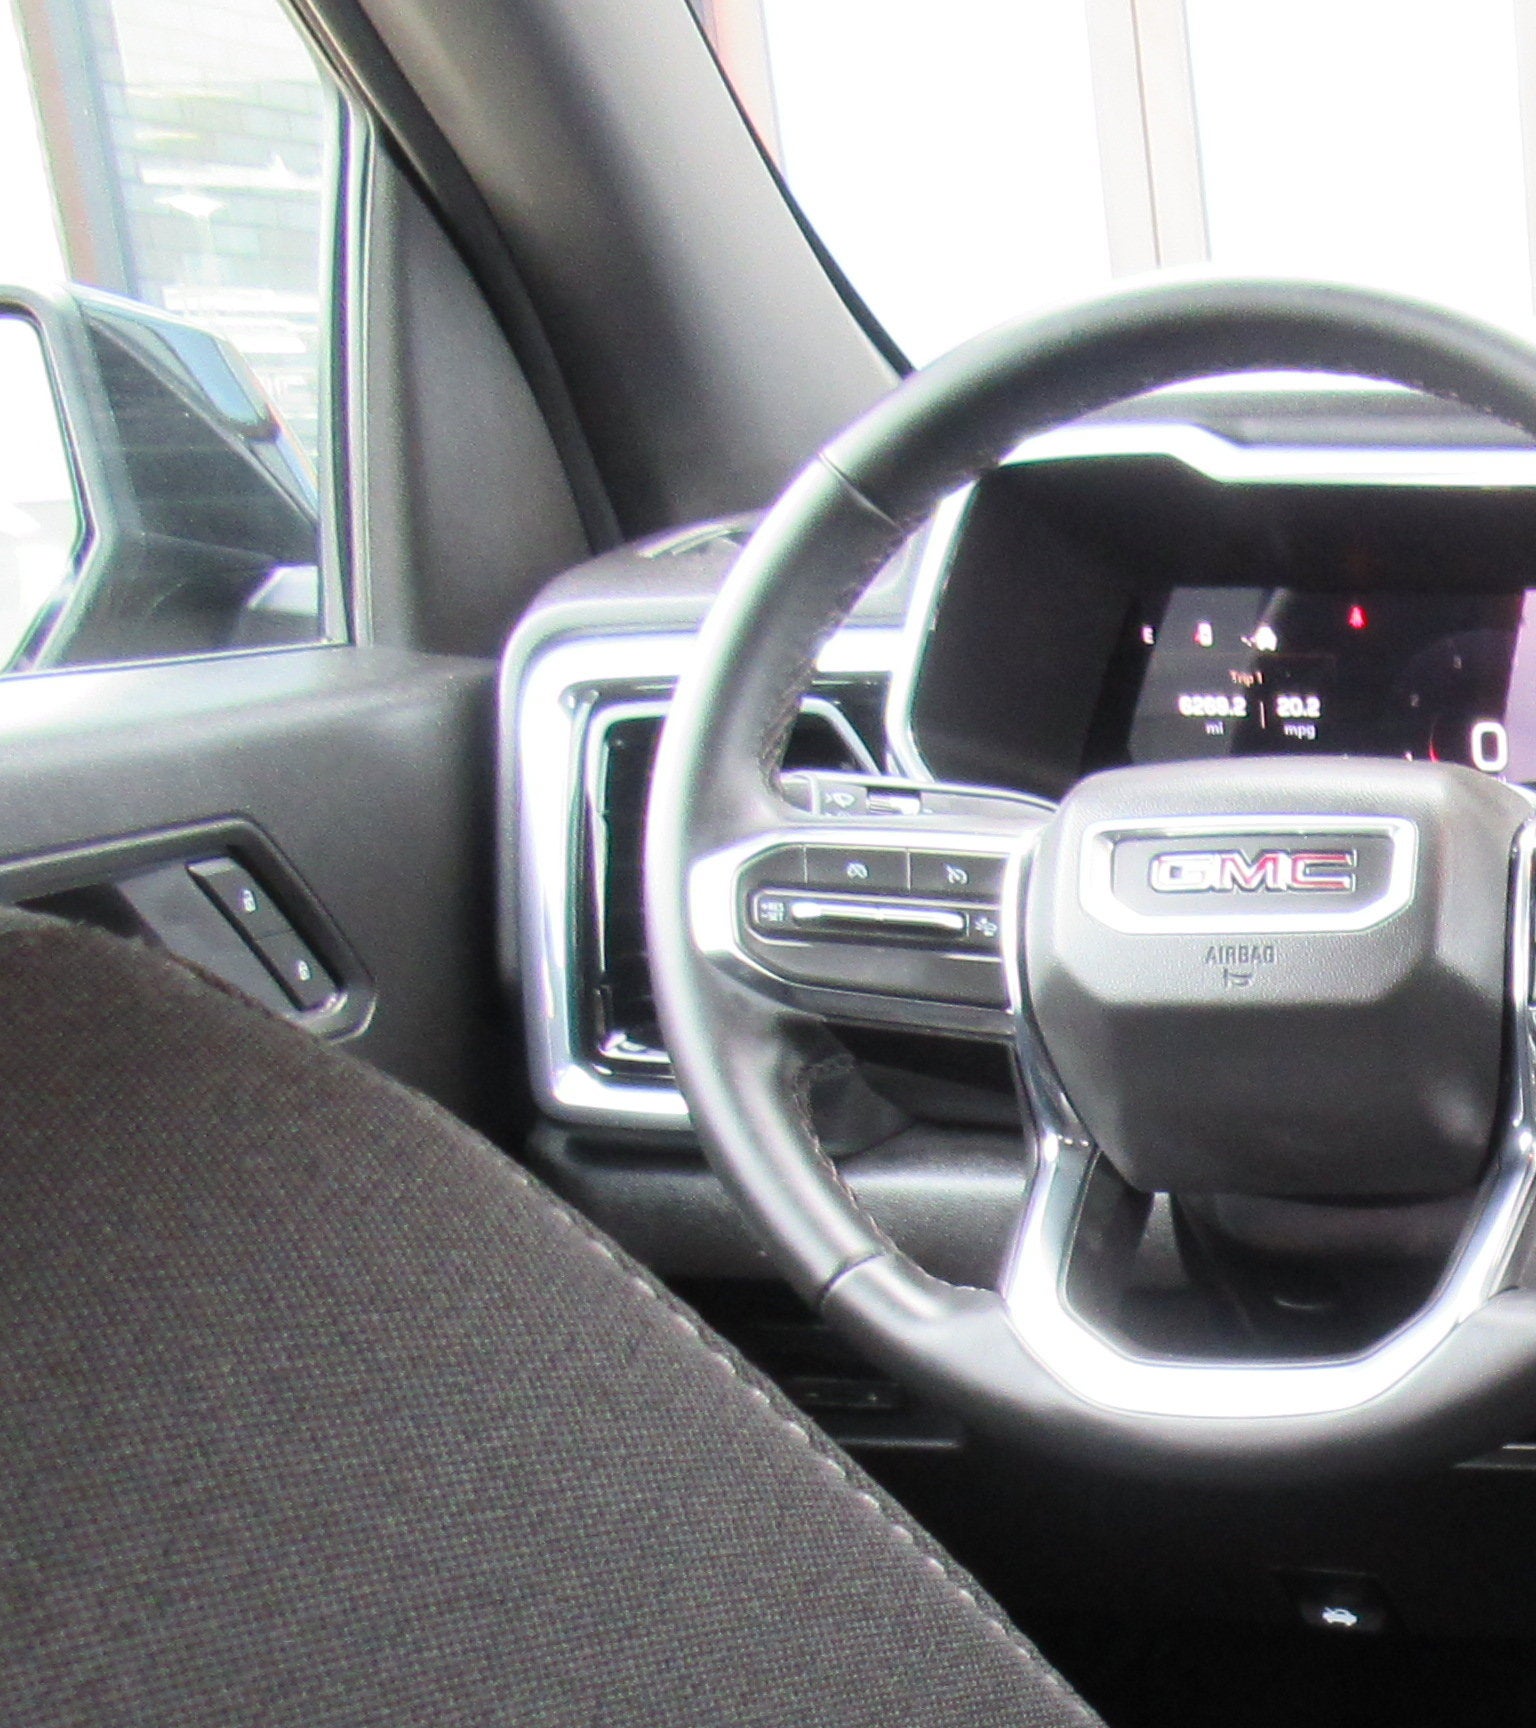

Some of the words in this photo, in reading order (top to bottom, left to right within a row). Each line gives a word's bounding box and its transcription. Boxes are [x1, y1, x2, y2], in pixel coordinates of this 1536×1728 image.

[1142, 626, 1154, 645] E
[1231, 670, 1253, 687] Trip
[1276, 695, 1321, 718] 20.2
[1205, 721, 1224, 735] mi
[1284, 722, 1316, 739] mpg
[1471, 721, 1508, 772] 0
[1149, 849, 1357, 893] GMC
[1205, 945, 1276, 965] AIRBAG
